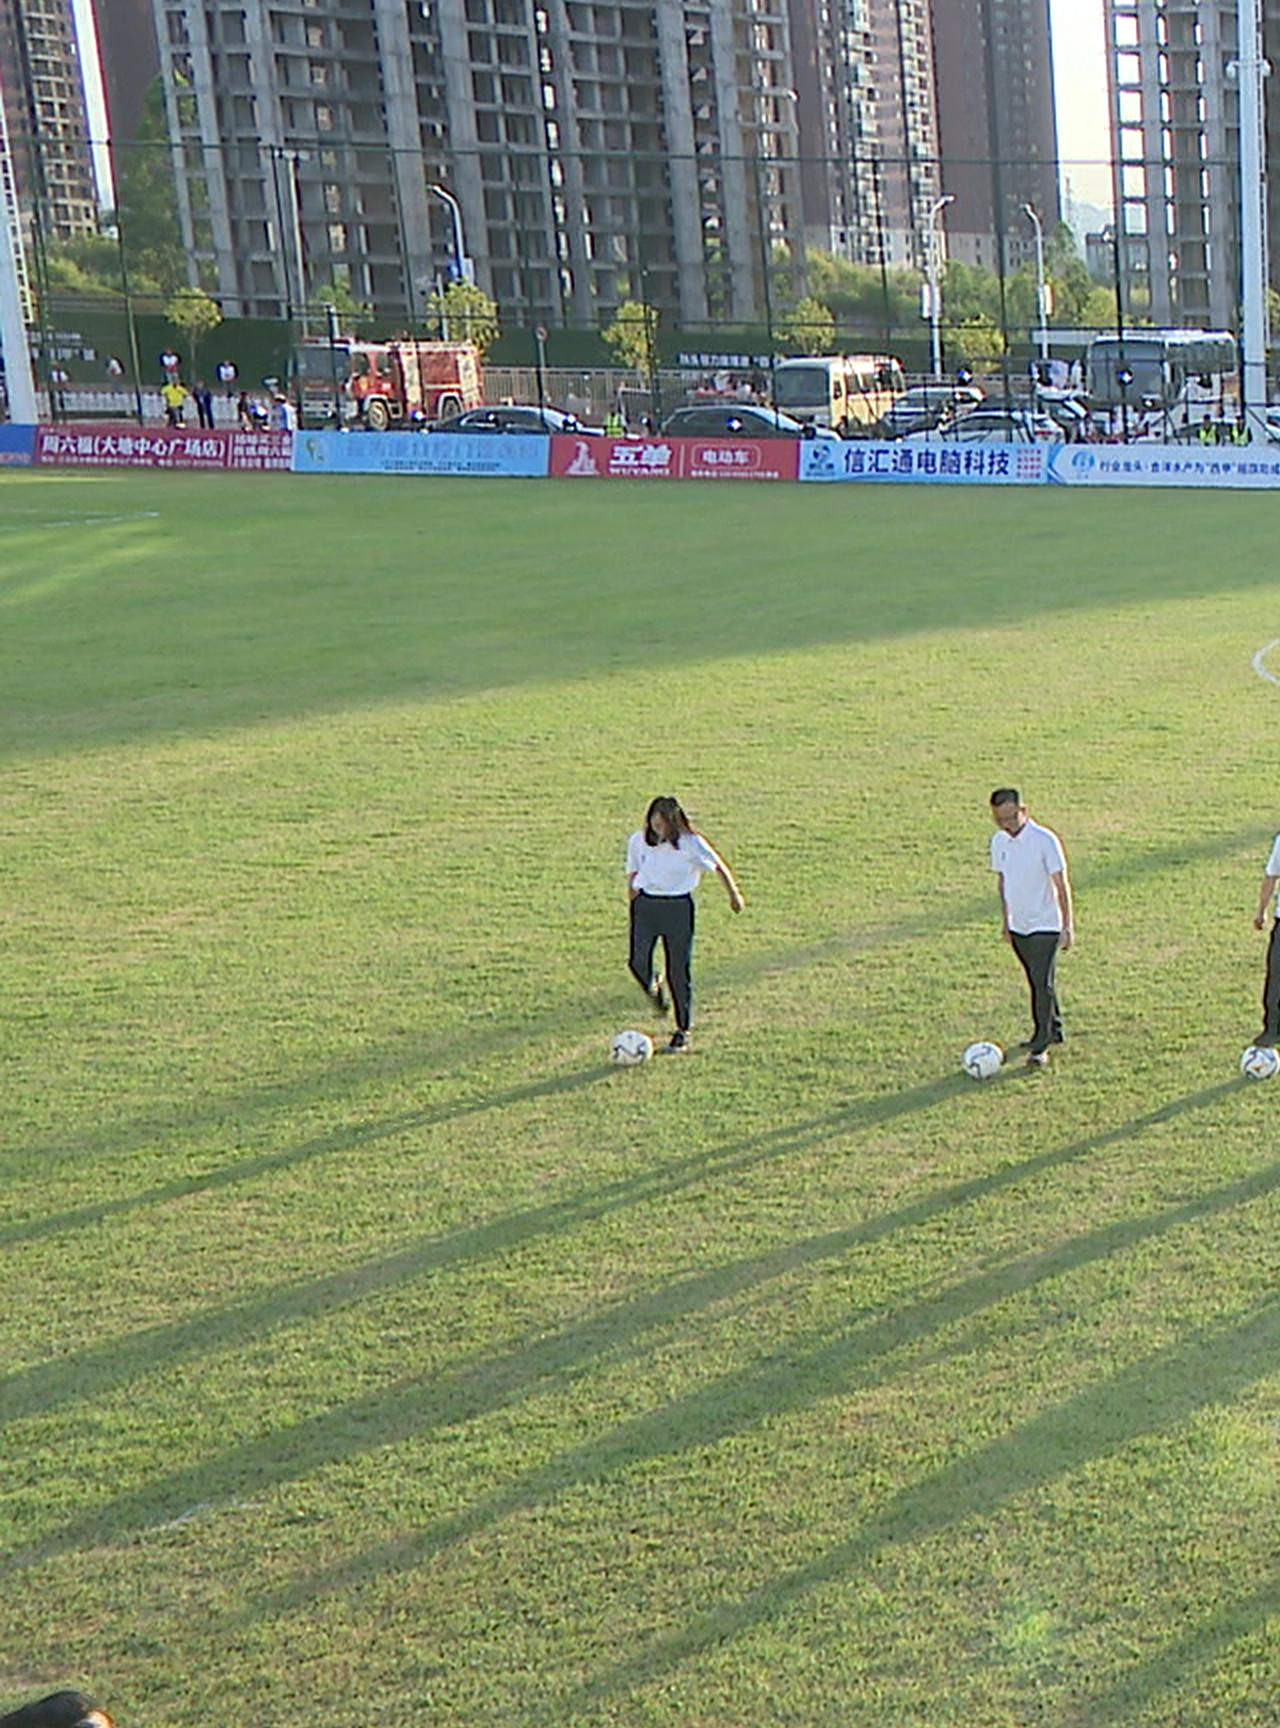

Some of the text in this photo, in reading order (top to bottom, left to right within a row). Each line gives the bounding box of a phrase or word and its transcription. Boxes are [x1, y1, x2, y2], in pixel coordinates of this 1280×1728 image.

[702, 449, 750, 466] 电动车
[843, 448, 1010, 476] 信汇通电脑科技
